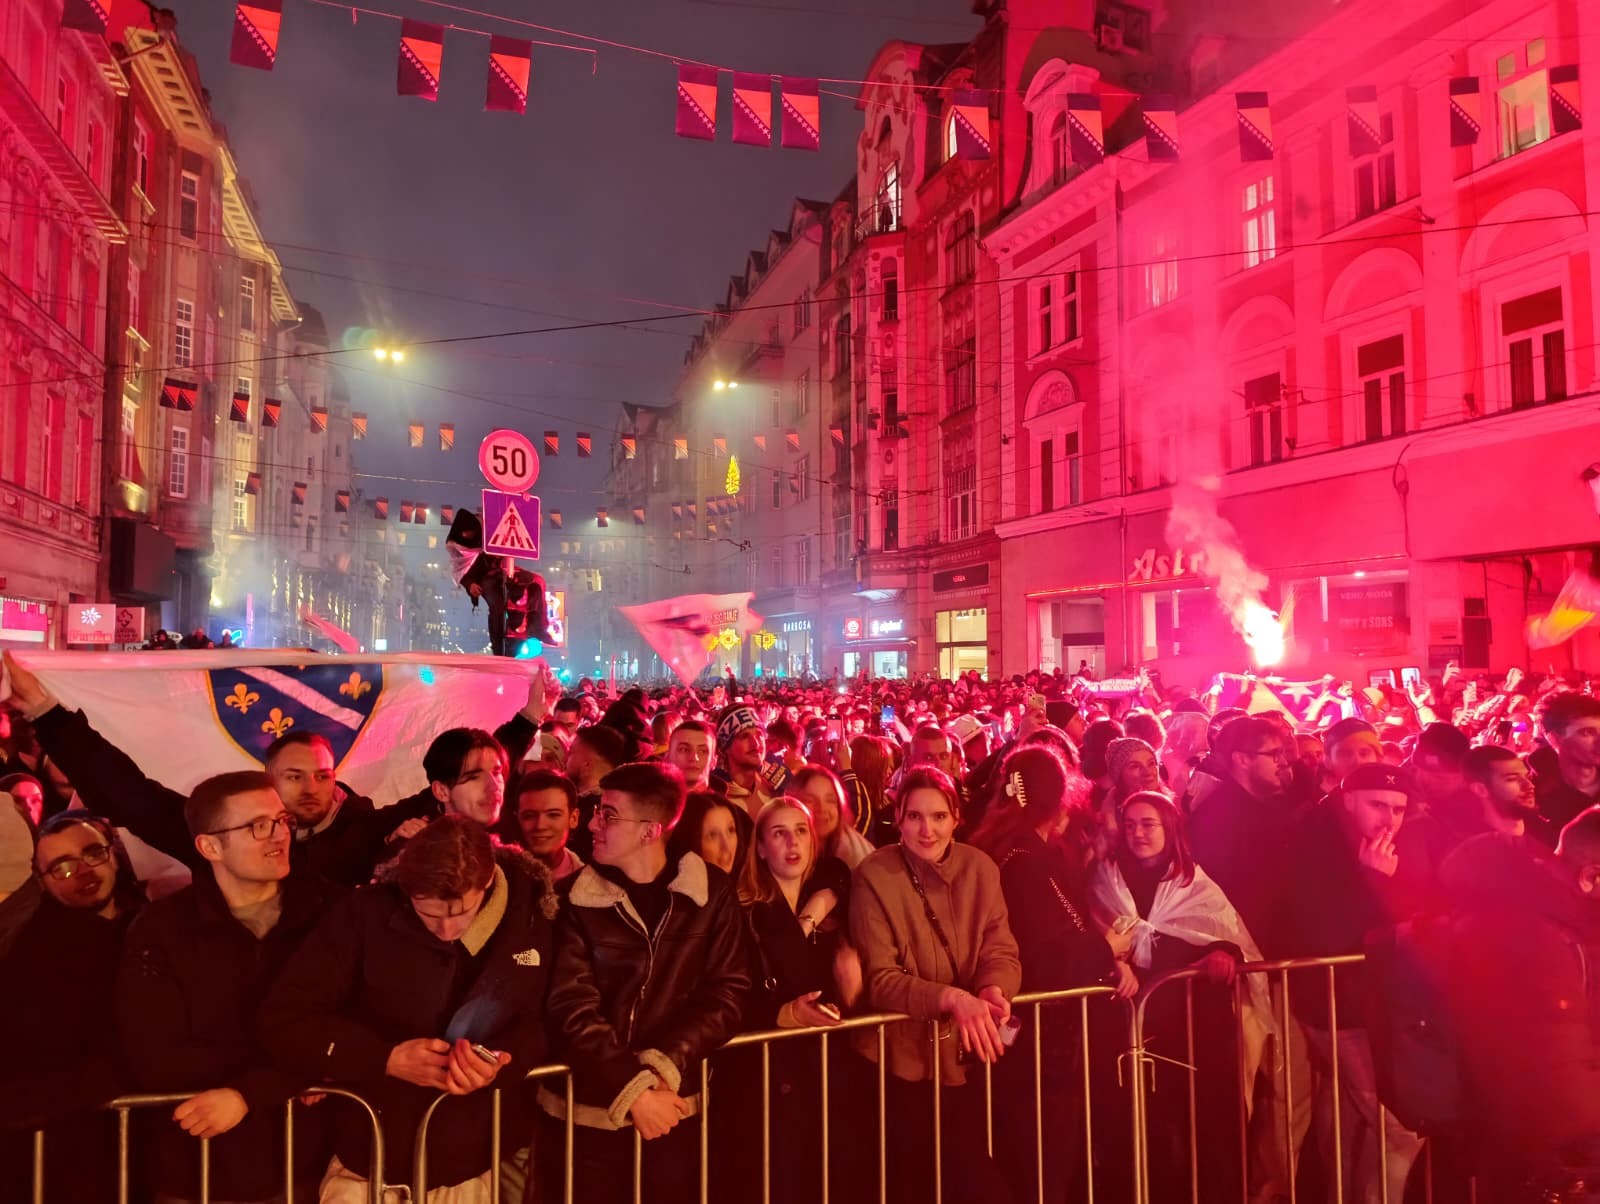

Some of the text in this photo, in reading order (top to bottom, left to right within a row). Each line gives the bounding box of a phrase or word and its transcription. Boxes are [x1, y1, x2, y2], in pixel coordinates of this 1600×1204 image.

[493, 445, 526, 477] 50
[1127, 548, 1205, 580] Astr
[1369, 616, 1393, 627] SONS
